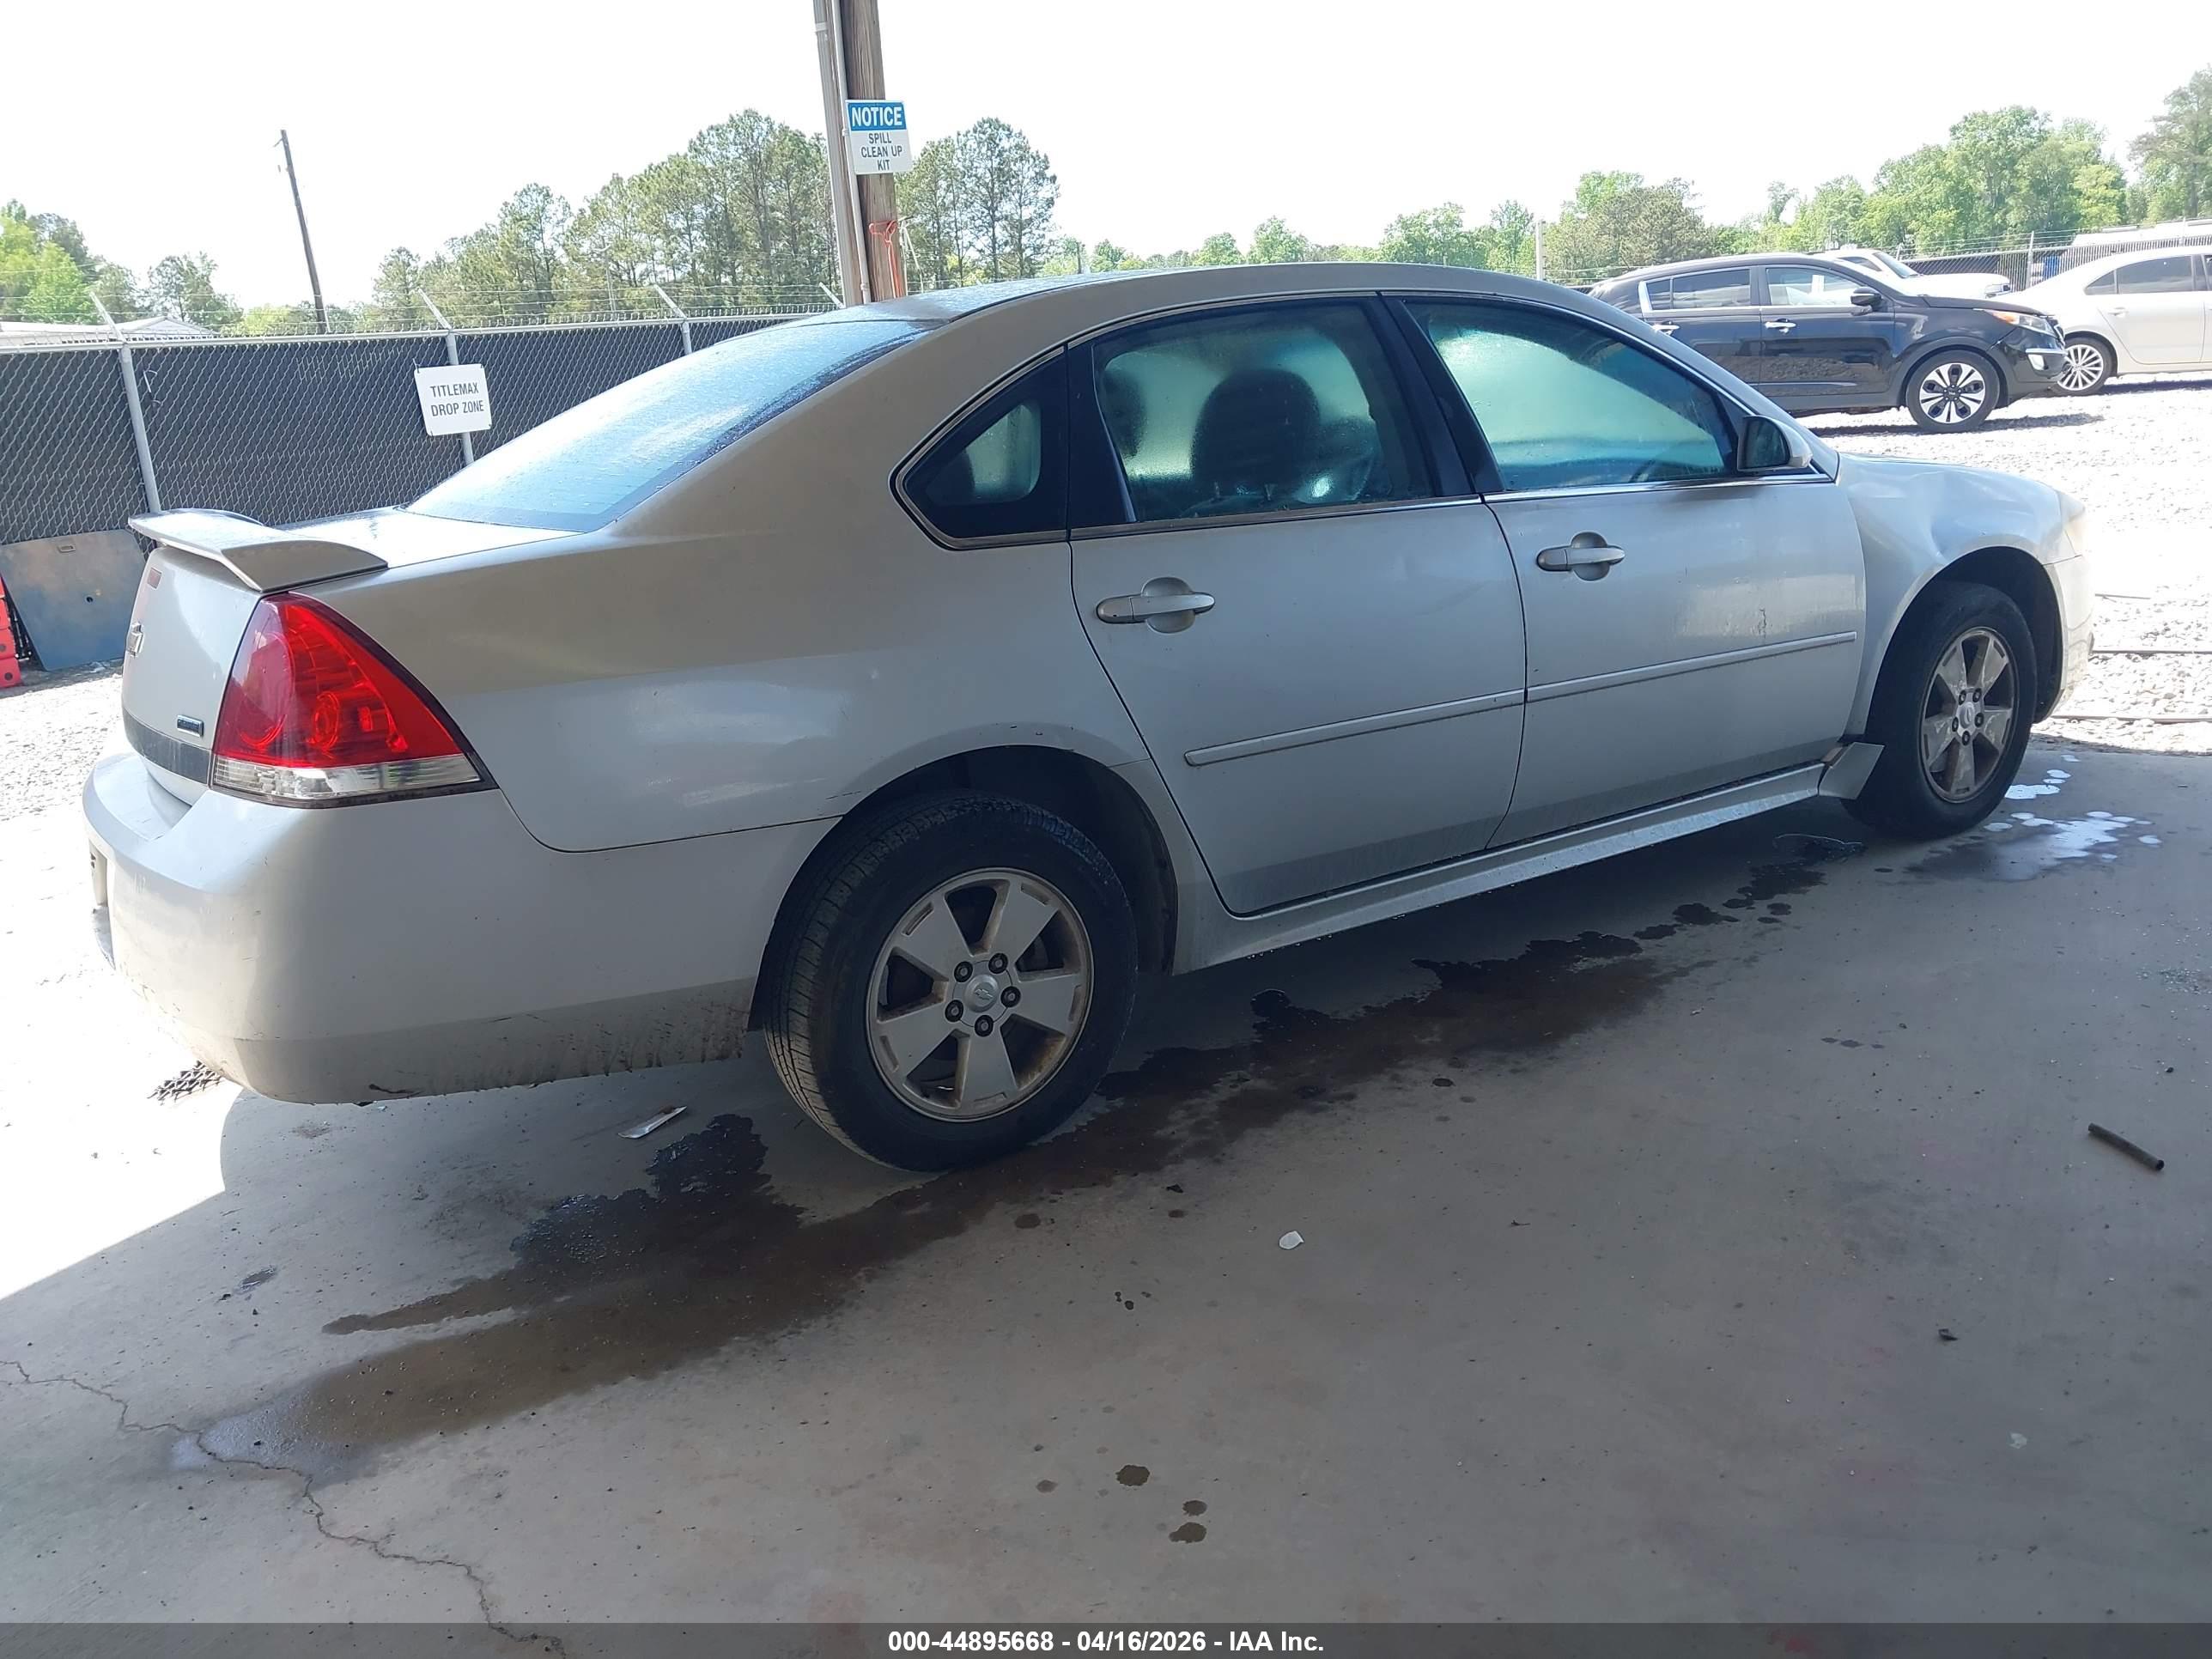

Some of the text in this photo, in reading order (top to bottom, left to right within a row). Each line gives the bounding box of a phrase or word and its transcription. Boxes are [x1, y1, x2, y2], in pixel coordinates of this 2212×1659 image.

[851, 106, 902, 127] NOTICE
[868, 132, 892, 144] SPILL
[860, 145, 902, 158] CLEAN UP
[877, 159, 890, 171] KIT
[429, 381, 479, 398] TITLEMAX
[430, 399, 484, 416] DROP ZONE
